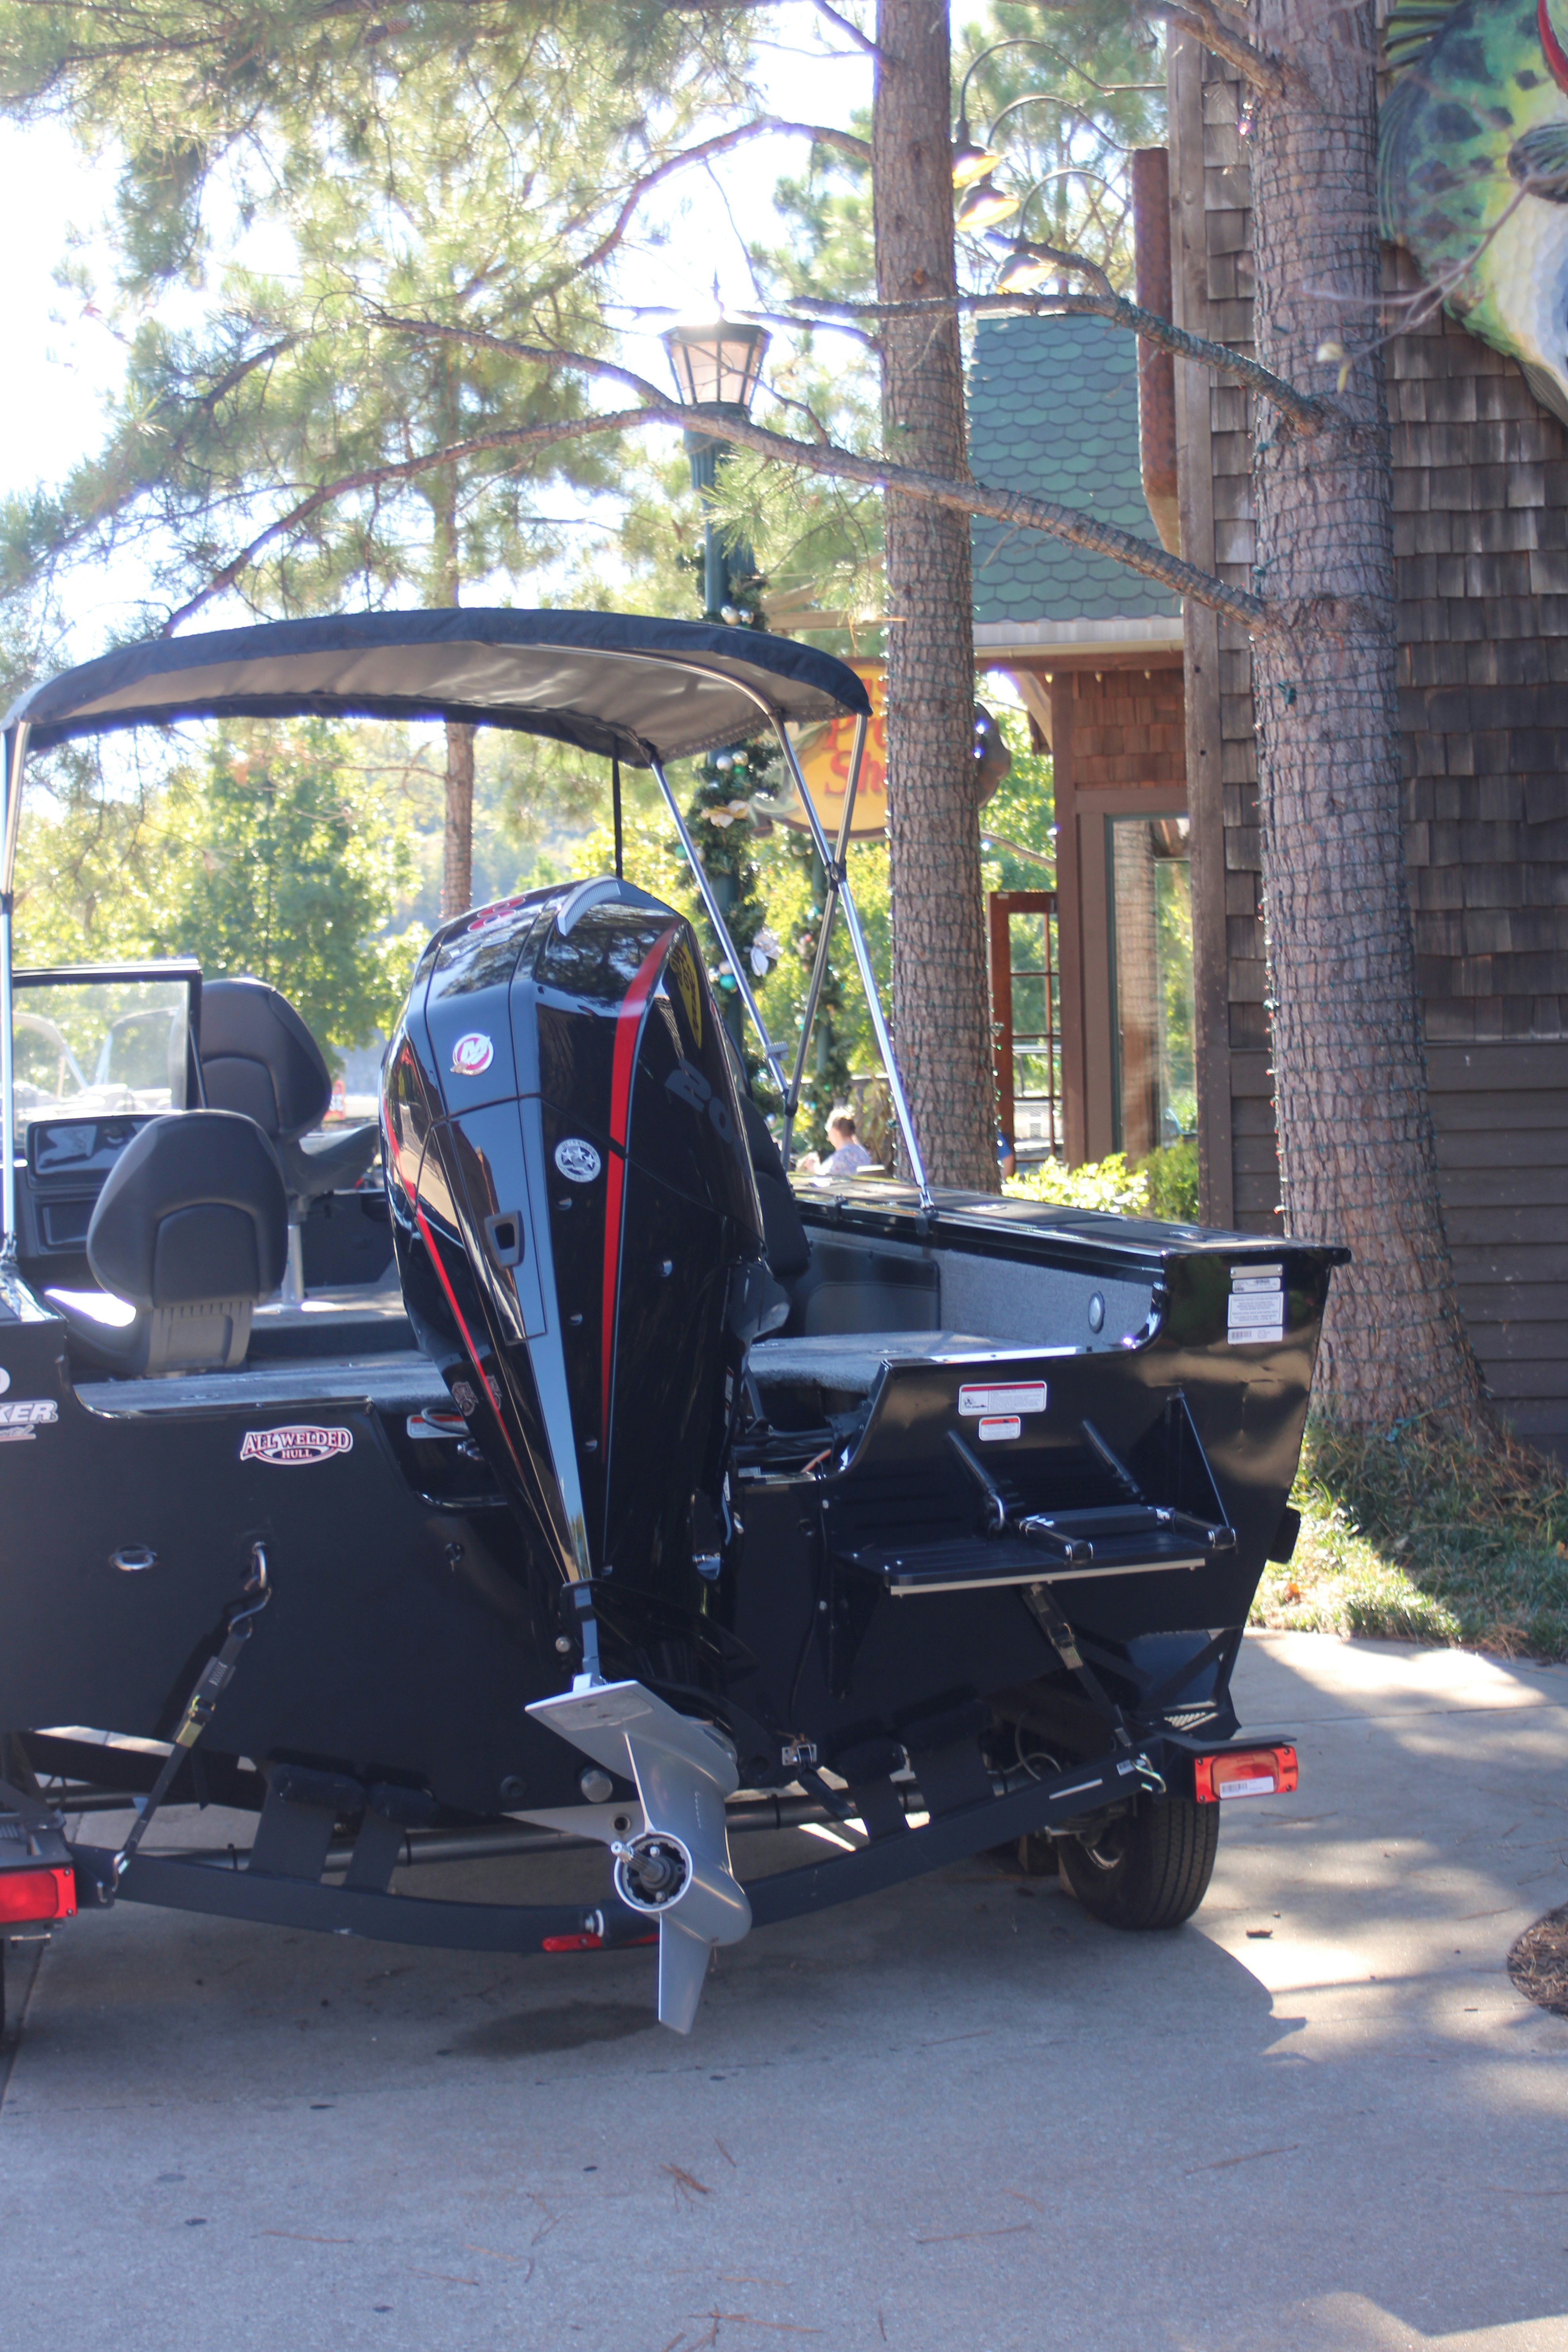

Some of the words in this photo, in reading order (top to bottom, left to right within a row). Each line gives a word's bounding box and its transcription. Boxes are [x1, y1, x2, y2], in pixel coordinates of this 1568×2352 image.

[243, 1433, 277, 1456] ALL
[279, 1431, 350, 1449] WELDED
[281, 1448, 313, 1459] HULL
